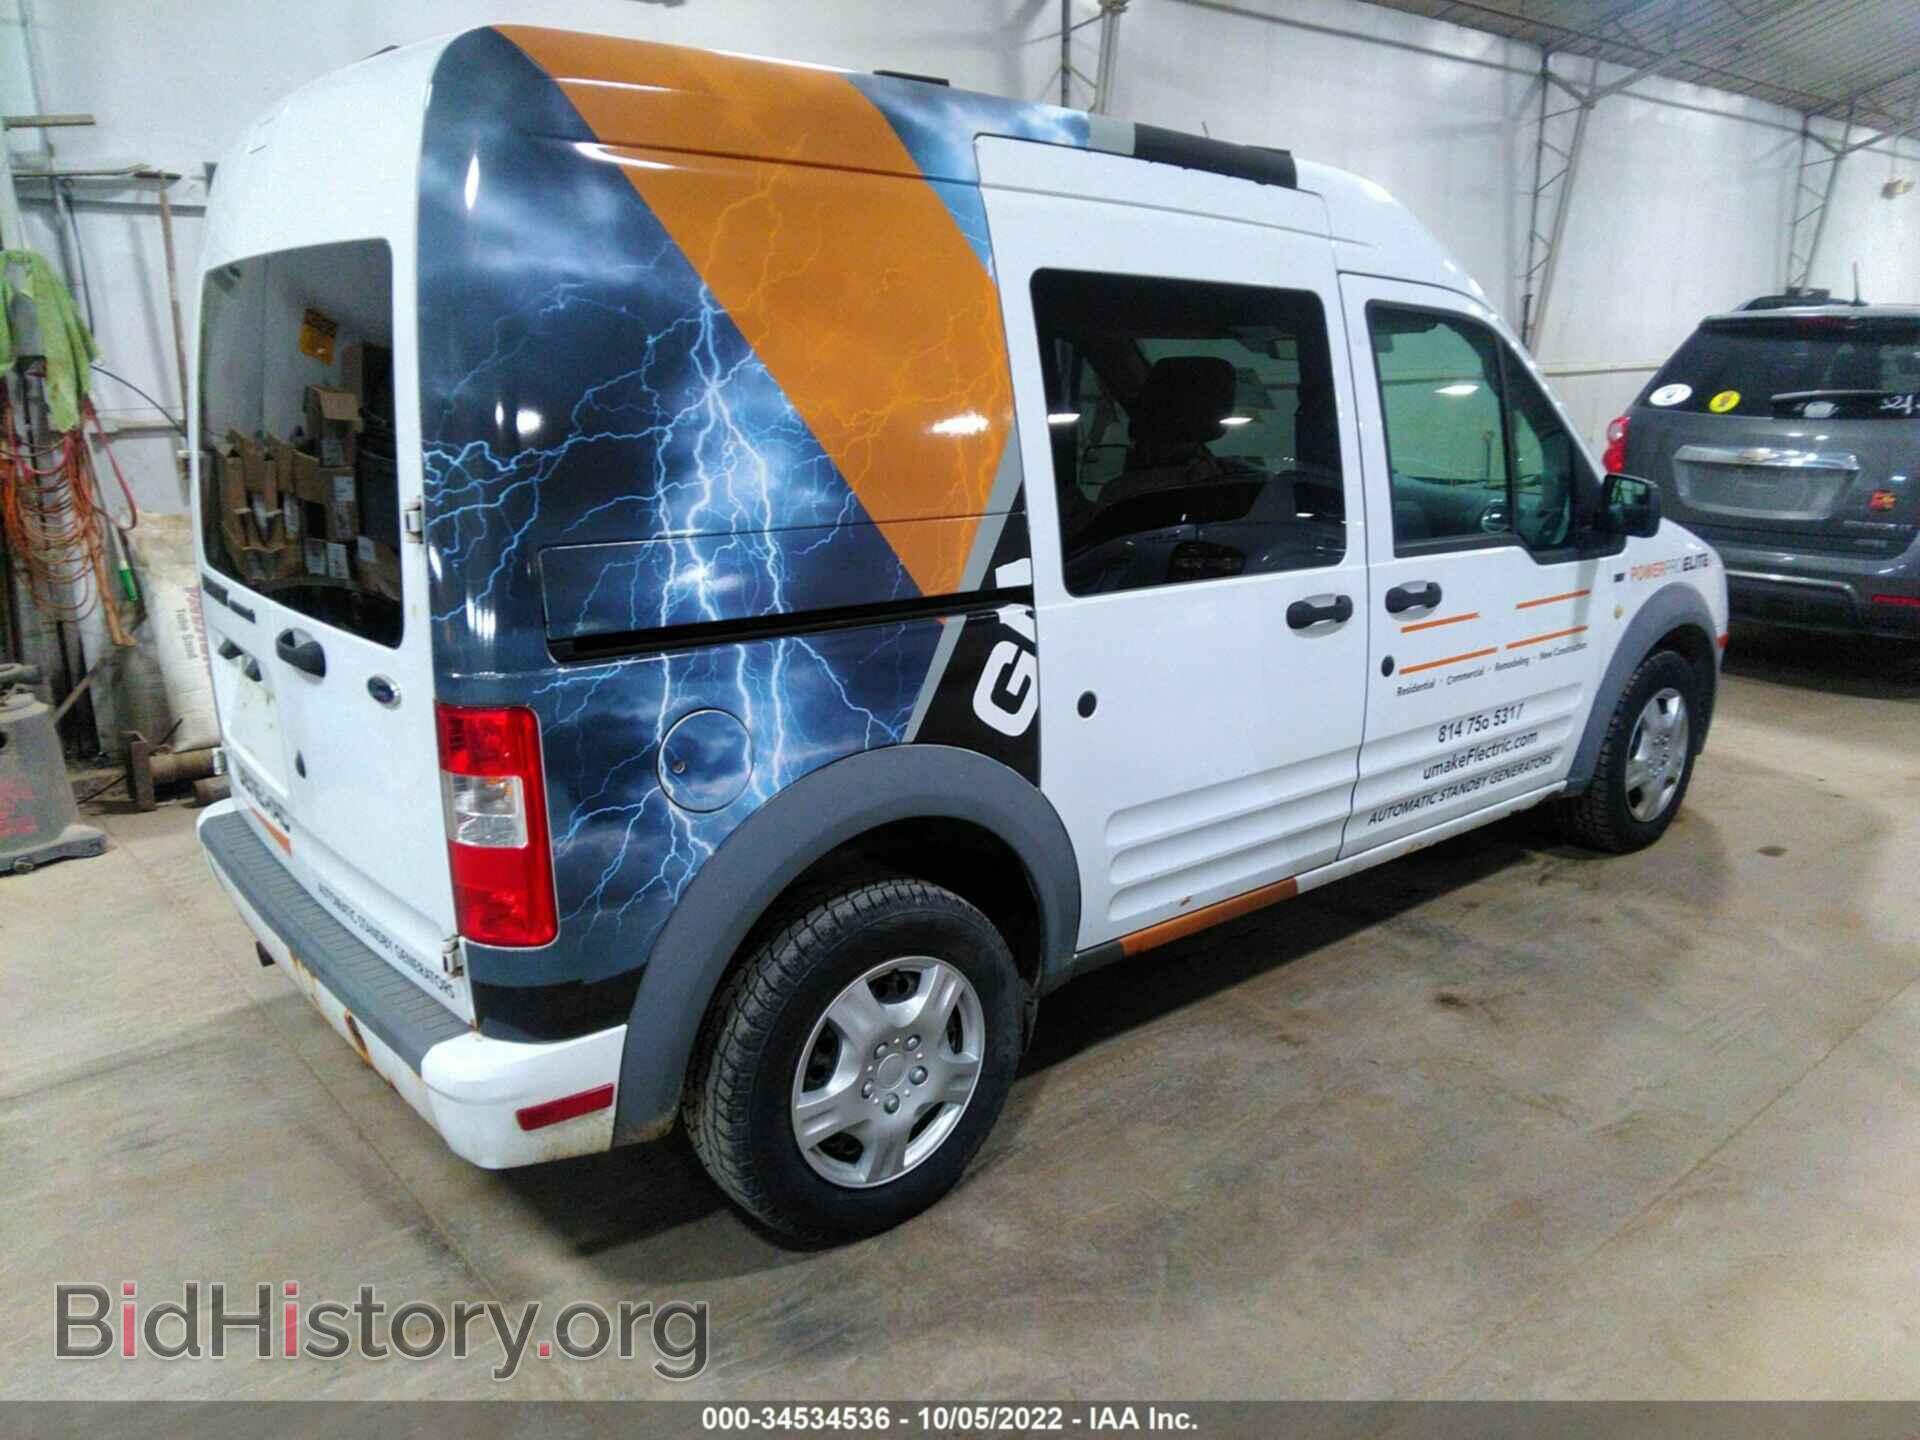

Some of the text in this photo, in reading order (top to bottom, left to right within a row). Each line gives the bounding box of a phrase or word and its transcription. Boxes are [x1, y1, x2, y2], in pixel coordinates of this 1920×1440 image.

[1396, 678, 1436, 696] Residential
[1446, 666, 1485, 686] Commercial
[1437, 719, 1464, 744] 814
[1492, 702, 1525, 727] 5317
[1367, 753, 1555, 826] AUTOMATIC STANDBY GENERATORS
